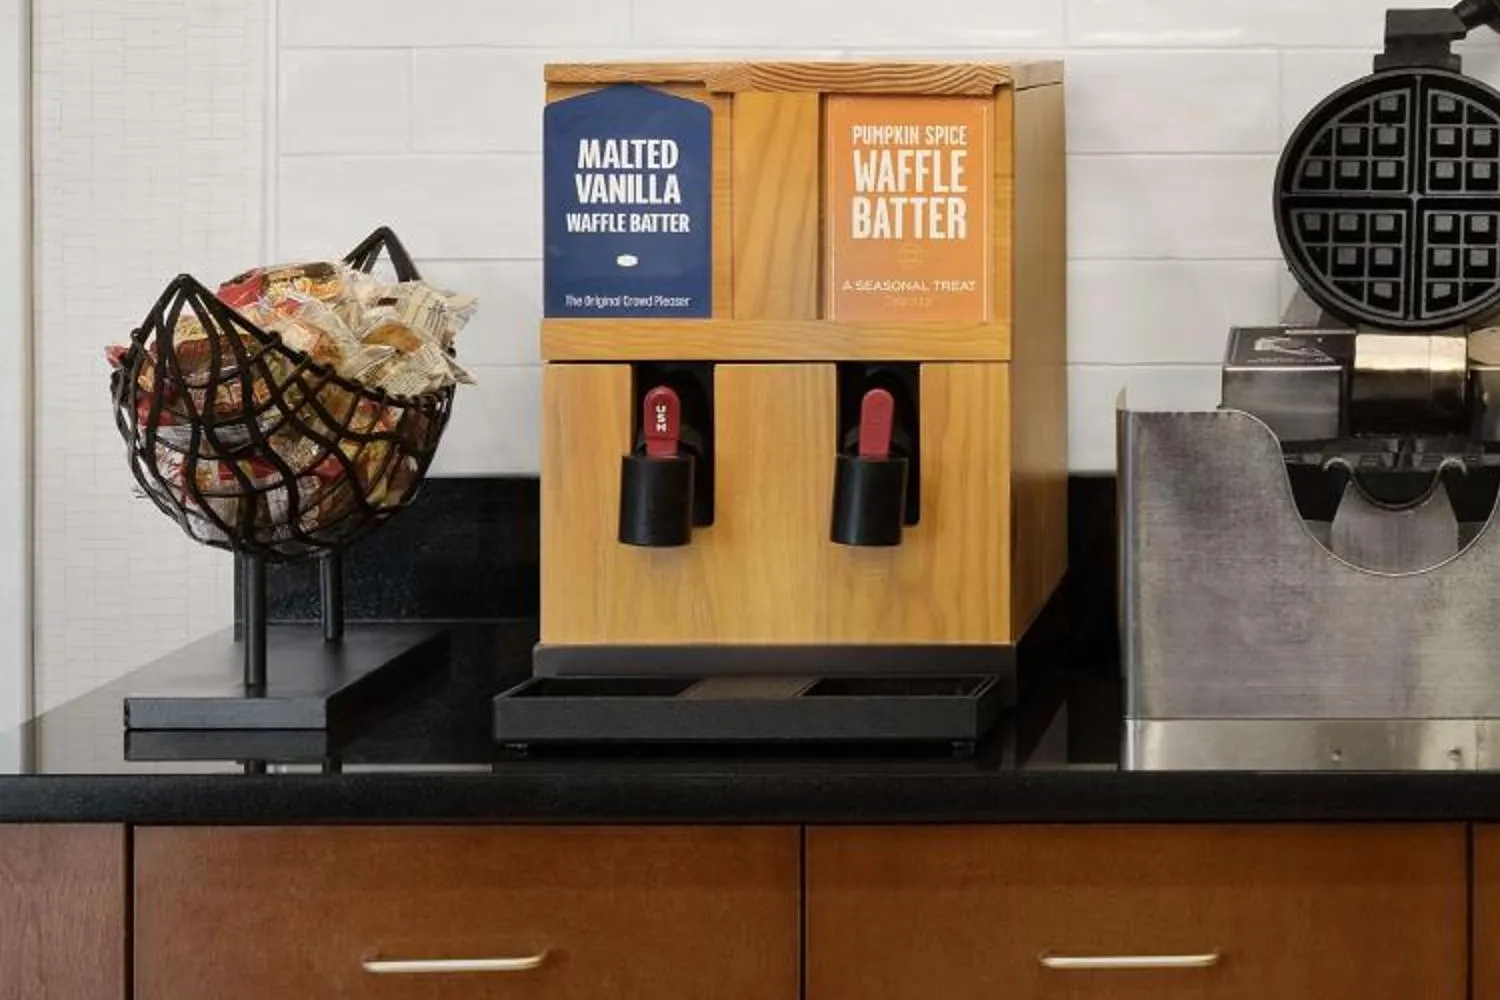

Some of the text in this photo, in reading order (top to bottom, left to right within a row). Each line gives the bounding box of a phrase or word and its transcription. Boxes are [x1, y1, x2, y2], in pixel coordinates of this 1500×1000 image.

[852, 125, 968, 146] PUMPKIN SPICE
[577, 138, 679, 169] MALTED
[852, 149, 968, 193] WAFFLE
[575, 173, 682, 205] VANILLA
[566, 213, 691, 233] WAFFLE BATTER
[852, 197, 968, 240] BATTER
[855, 279, 930, 292] SEASONAL
[933, 279, 977, 292] TREAT
[565, 295, 691, 309] The Original Crowd Pleaser
